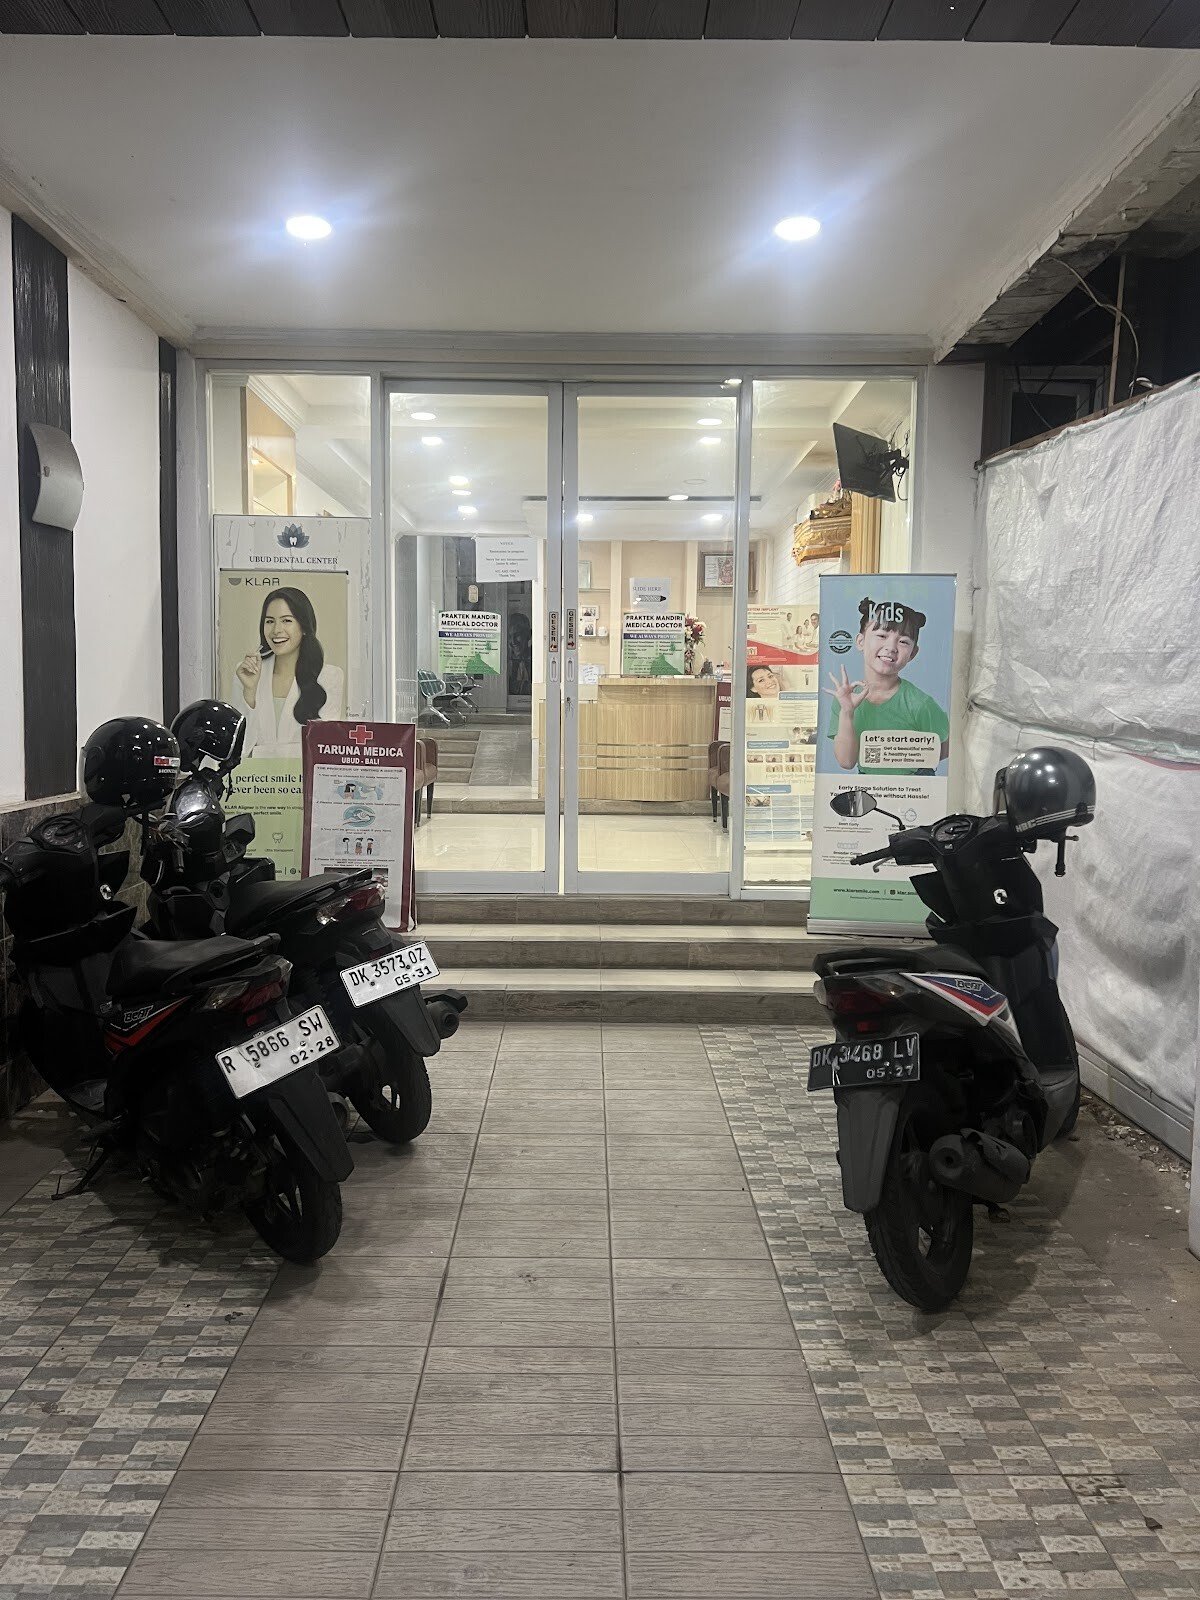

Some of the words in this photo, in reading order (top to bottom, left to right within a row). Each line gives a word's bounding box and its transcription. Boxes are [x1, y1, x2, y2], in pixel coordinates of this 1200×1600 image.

[274, 556, 305, 564] DENTAL
[307, 557, 338, 565] CENTER
[245, 577, 280, 586] KLAR
[868, 602, 904, 624] Kids
[910, 736, 934, 744] early!
[317, 744, 360, 756] TARUNA
[363, 747, 404, 757] MEDICA
[236, 774, 269, 784] perfect
[271, 774, 297, 782] smile
[253, 786, 275, 794] been
[349, 967, 370, 986] DK
[371, 954, 406, 978] 3573
[221, 1055, 236, 1073] R
[245, 1031, 289, 1062] 5866
[298, 1012, 323, 1036] SW
[813, 1050, 832, 1067] DK
[839, 1044, 883, 1063] 3468
[894, 1037, 916, 1059] LV
